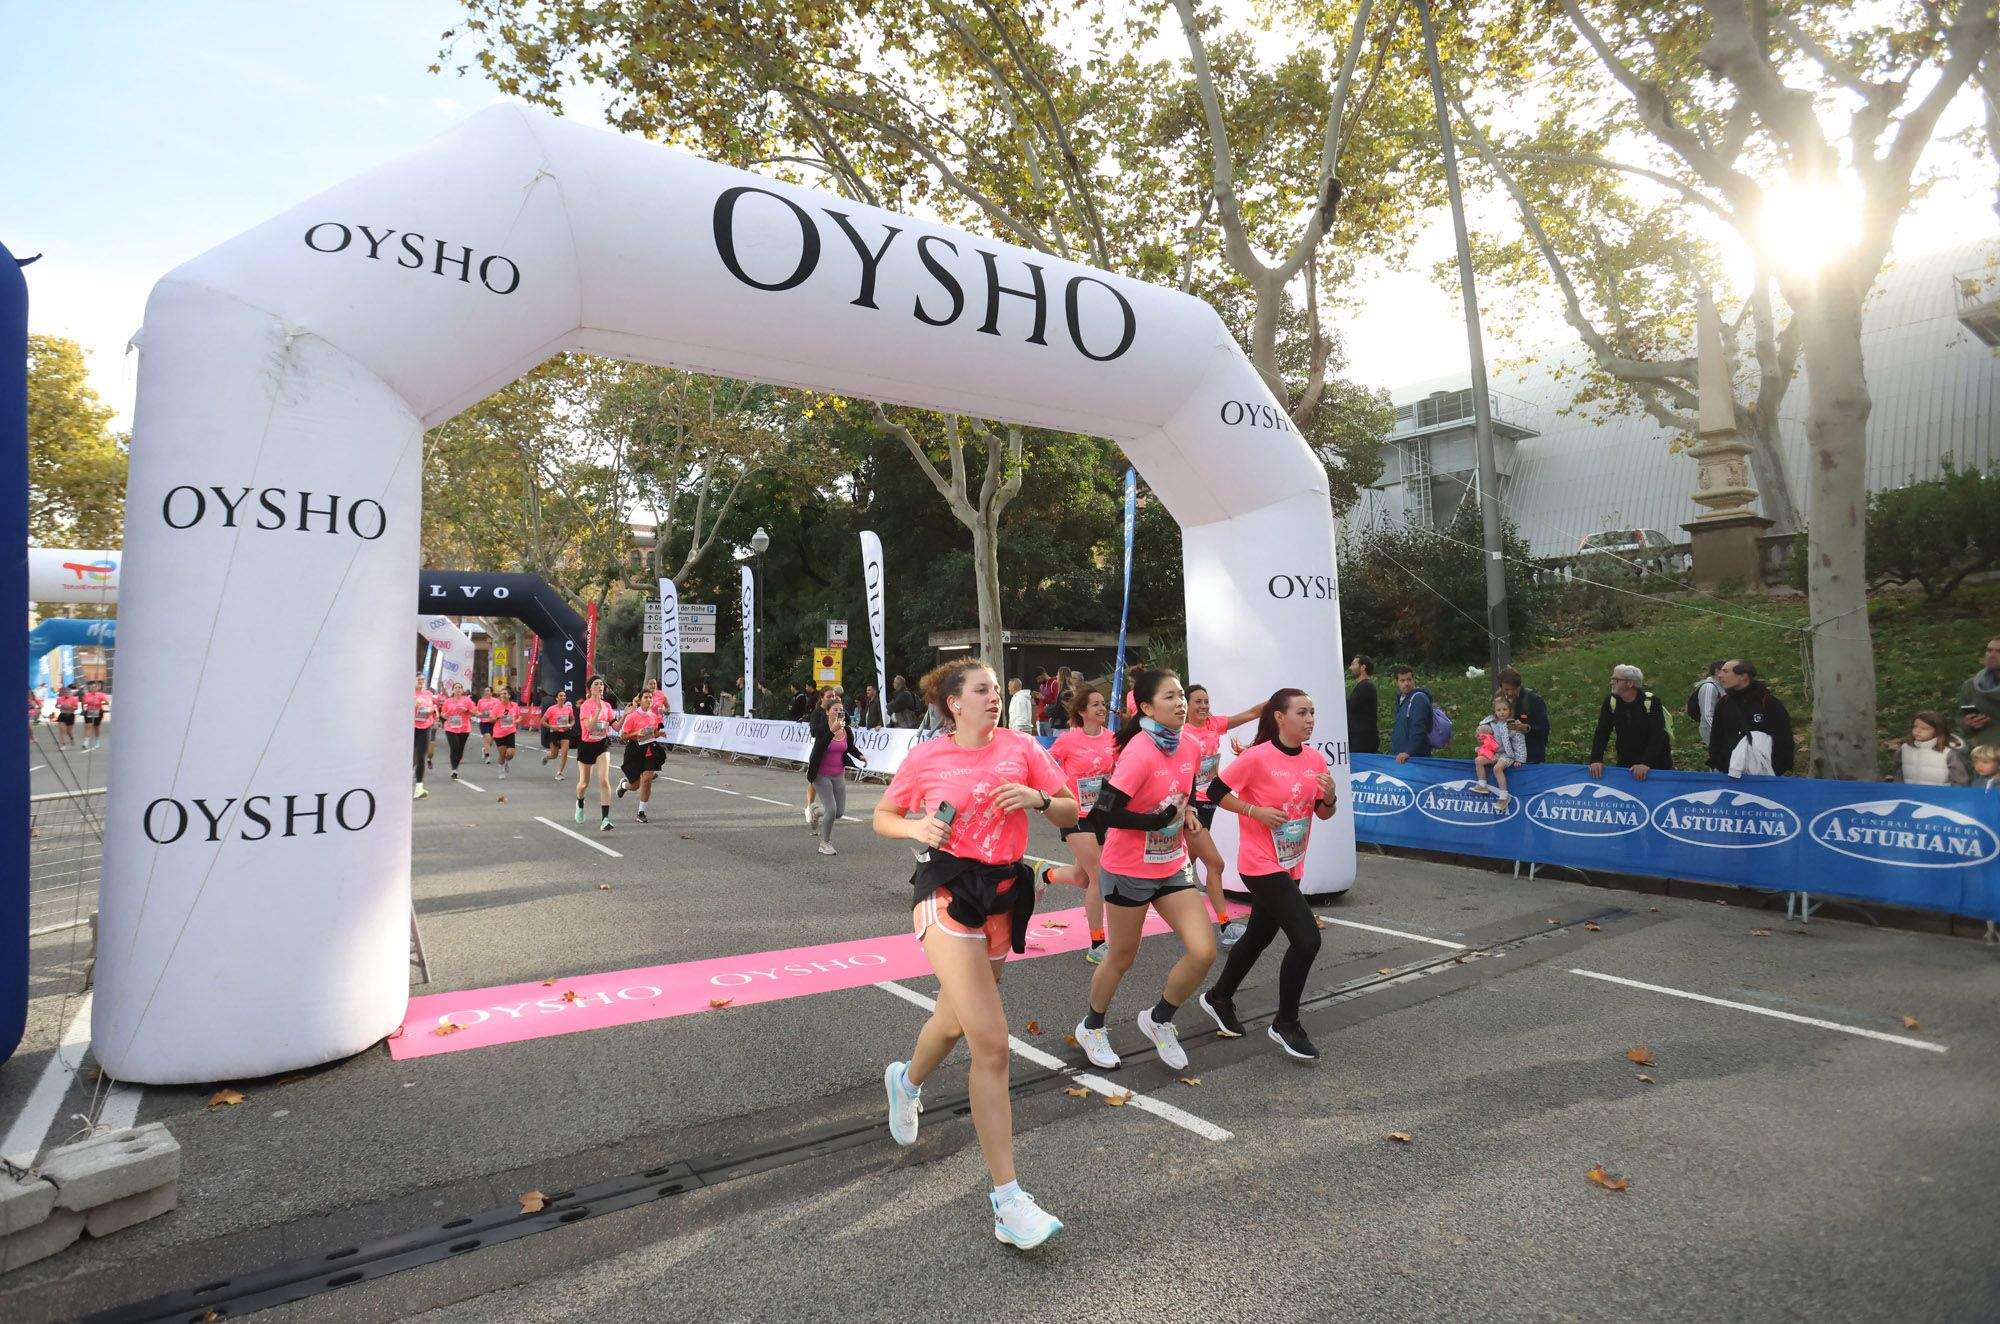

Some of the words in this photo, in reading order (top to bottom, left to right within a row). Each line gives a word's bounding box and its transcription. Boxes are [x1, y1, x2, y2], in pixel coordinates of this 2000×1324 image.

[304, 223, 520, 295] OYSHO
[713, 187, 1136, 362] OYSHO
[1221, 401, 1292, 433] OYSH
[163, 486, 387, 540] OYSHO
[430, 585, 509, 598] LVO
[1269, 575, 1337, 600] OYSH
[736, 721, 769, 739] OYSHO
[780, 724, 811, 743] OYSH
[853, 730, 890, 751] YSHO
[1352, 791, 1406, 807] TURIANA
[1533, 799, 1639, 826] ASTURIANA
[1553, 799, 1591, 807] CENTRAL
[1595, 801, 1636, 809] LECHERA
[1684, 807, 1730, 816] CENTRAL
[1734, 809, 1784, 818] LECHERA
[144, 788, 378, 844] OYSHO
[1660, 806, 1788, 836] ASTURIANA
[1851, 817, 1909, 829] CENTRAL
[1915, 823, 1979, 836] LECHERA
[1821, 817, 1983, 857] ASTURIANA
[709, 953, 888, 987] OYSHO
[437, 984, 664, 1026] OYSHO
